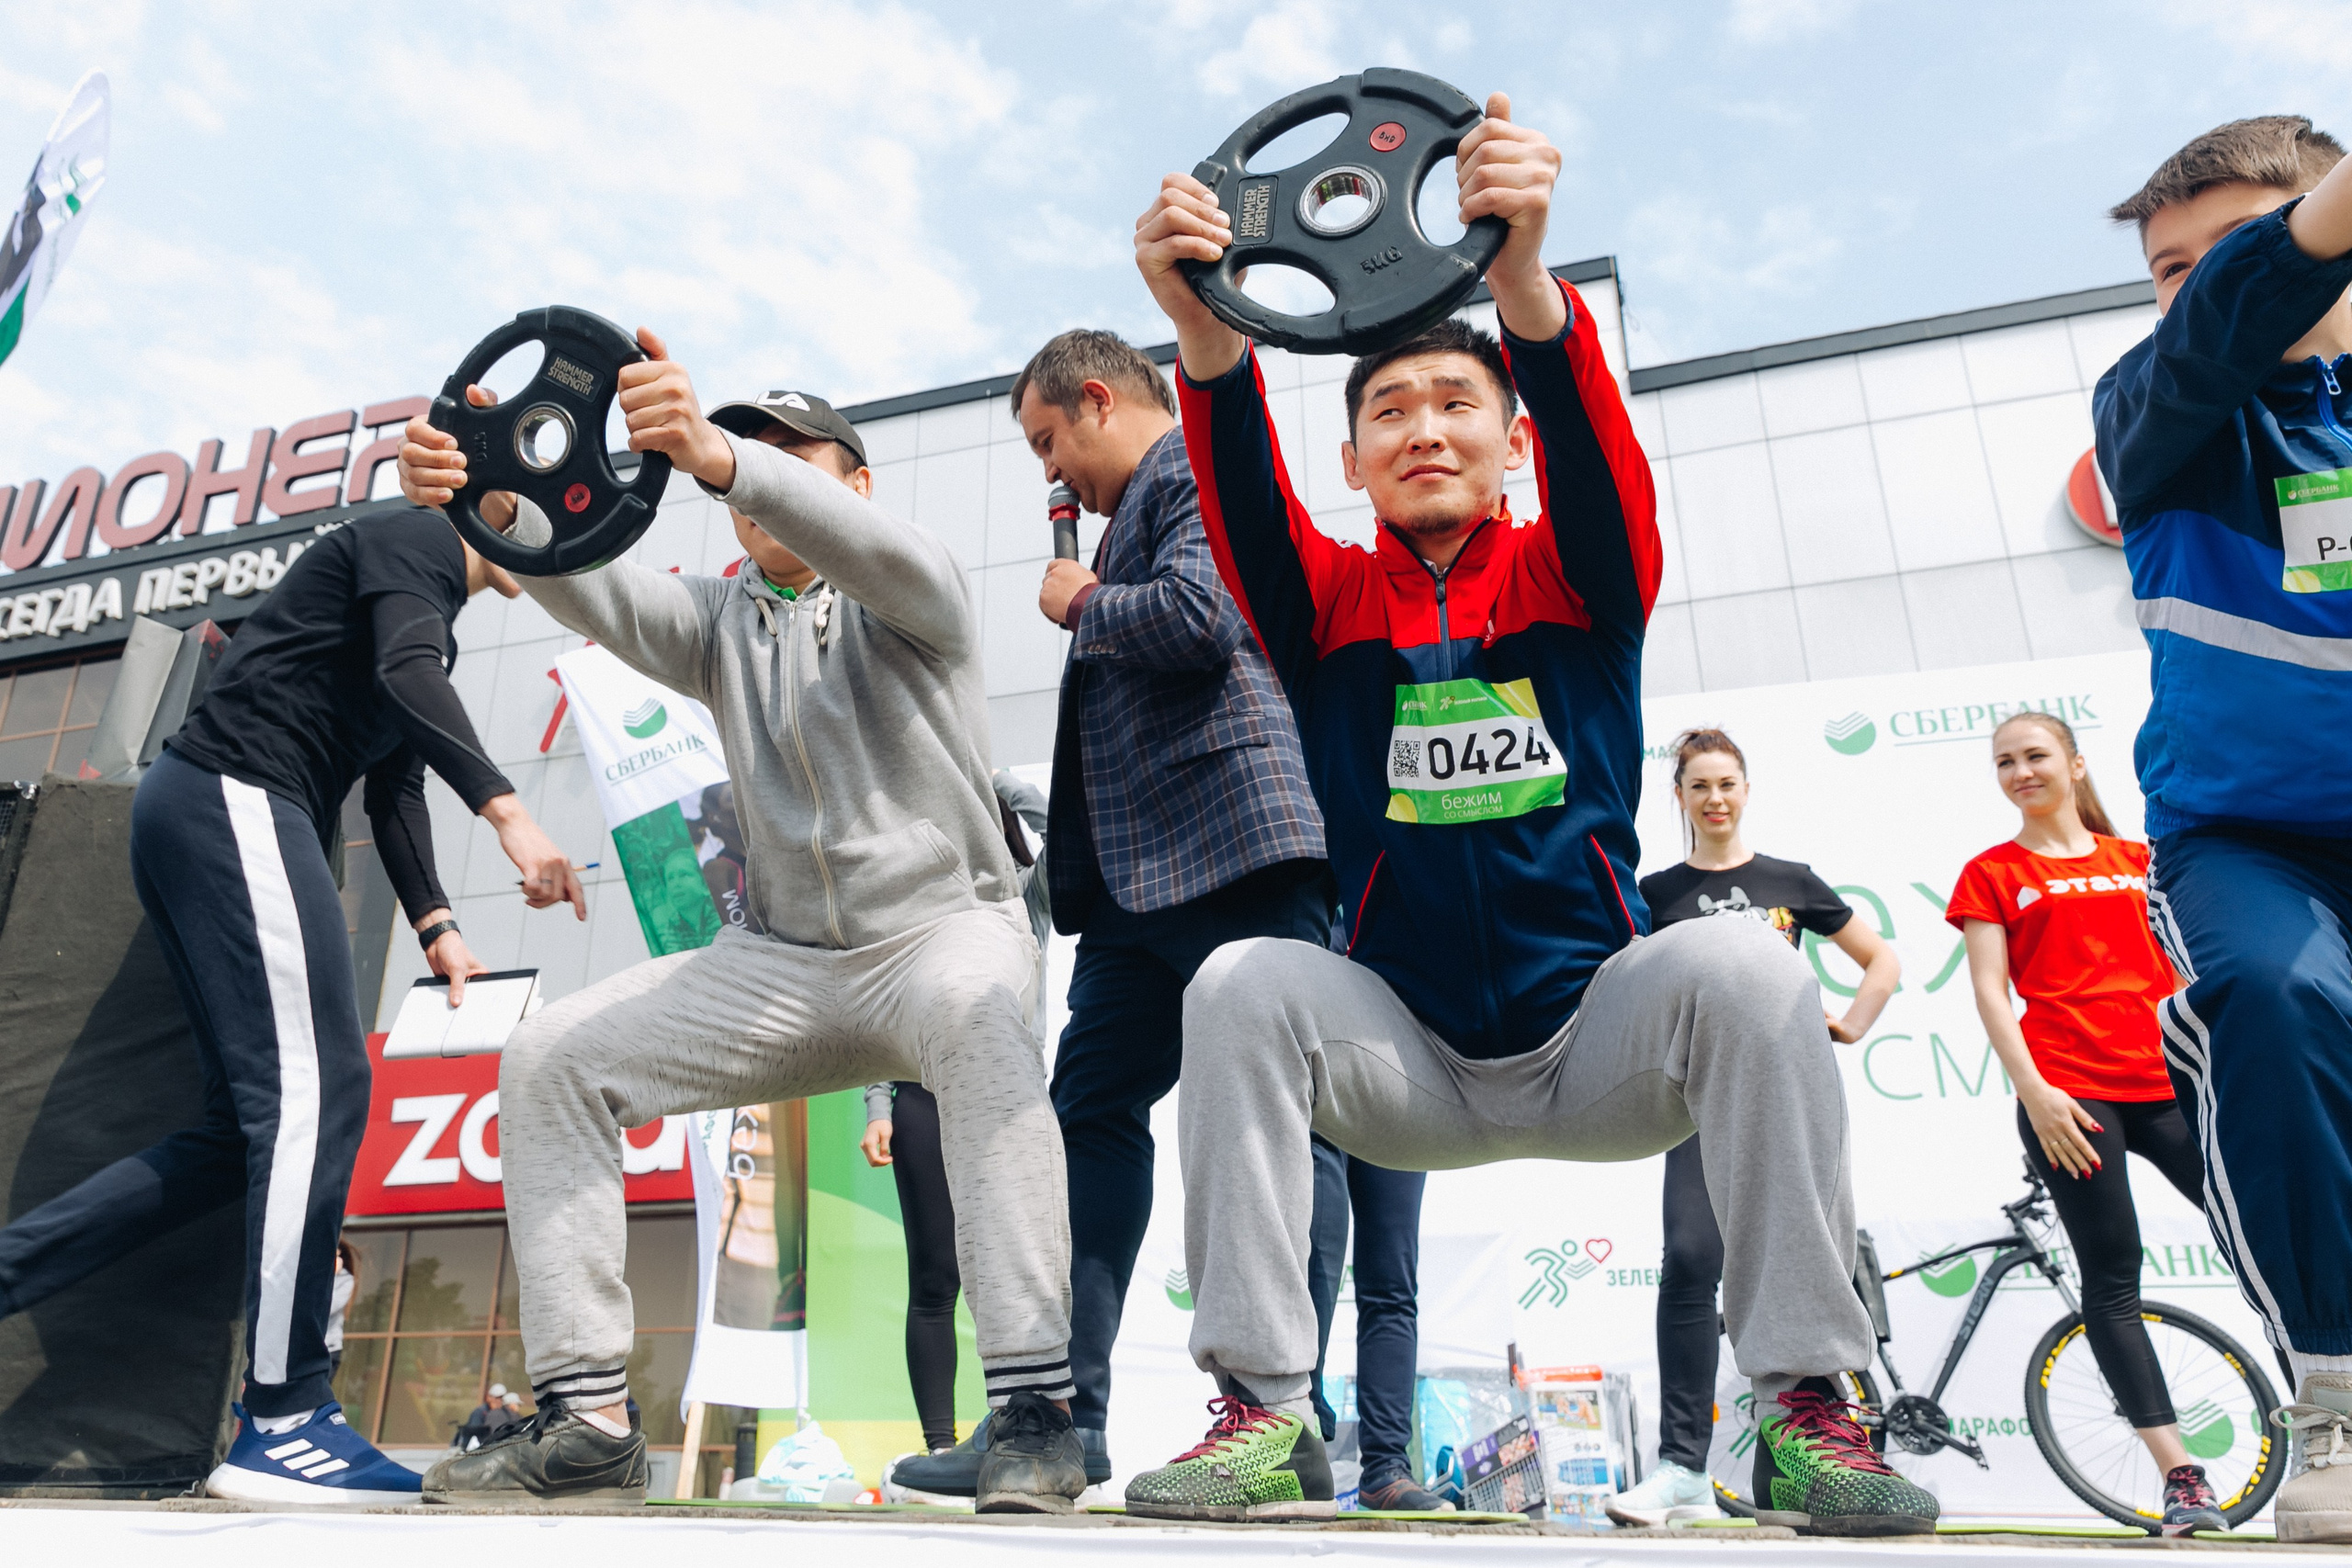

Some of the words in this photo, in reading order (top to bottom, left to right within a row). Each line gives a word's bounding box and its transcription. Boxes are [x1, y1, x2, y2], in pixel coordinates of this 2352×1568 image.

[1240, 188, 1258, 236] HAMMER
[1253, 185, 1270, 237] STRENGTH
[1360, 245, 1403, 275] 5KG
[548, 367, 592, 395] STRENGTH
[553, 356, 594, 384] HAMMER
[0, 396, 434, 571] ИОНЕР
[132, 536, 318, 615] ПЕРВЫ
[605, 734, 705, 781] СБЕРБАНК
[1428, 726, 1551, 780] 0424
[1442, 791, 1502, 810] бежим
